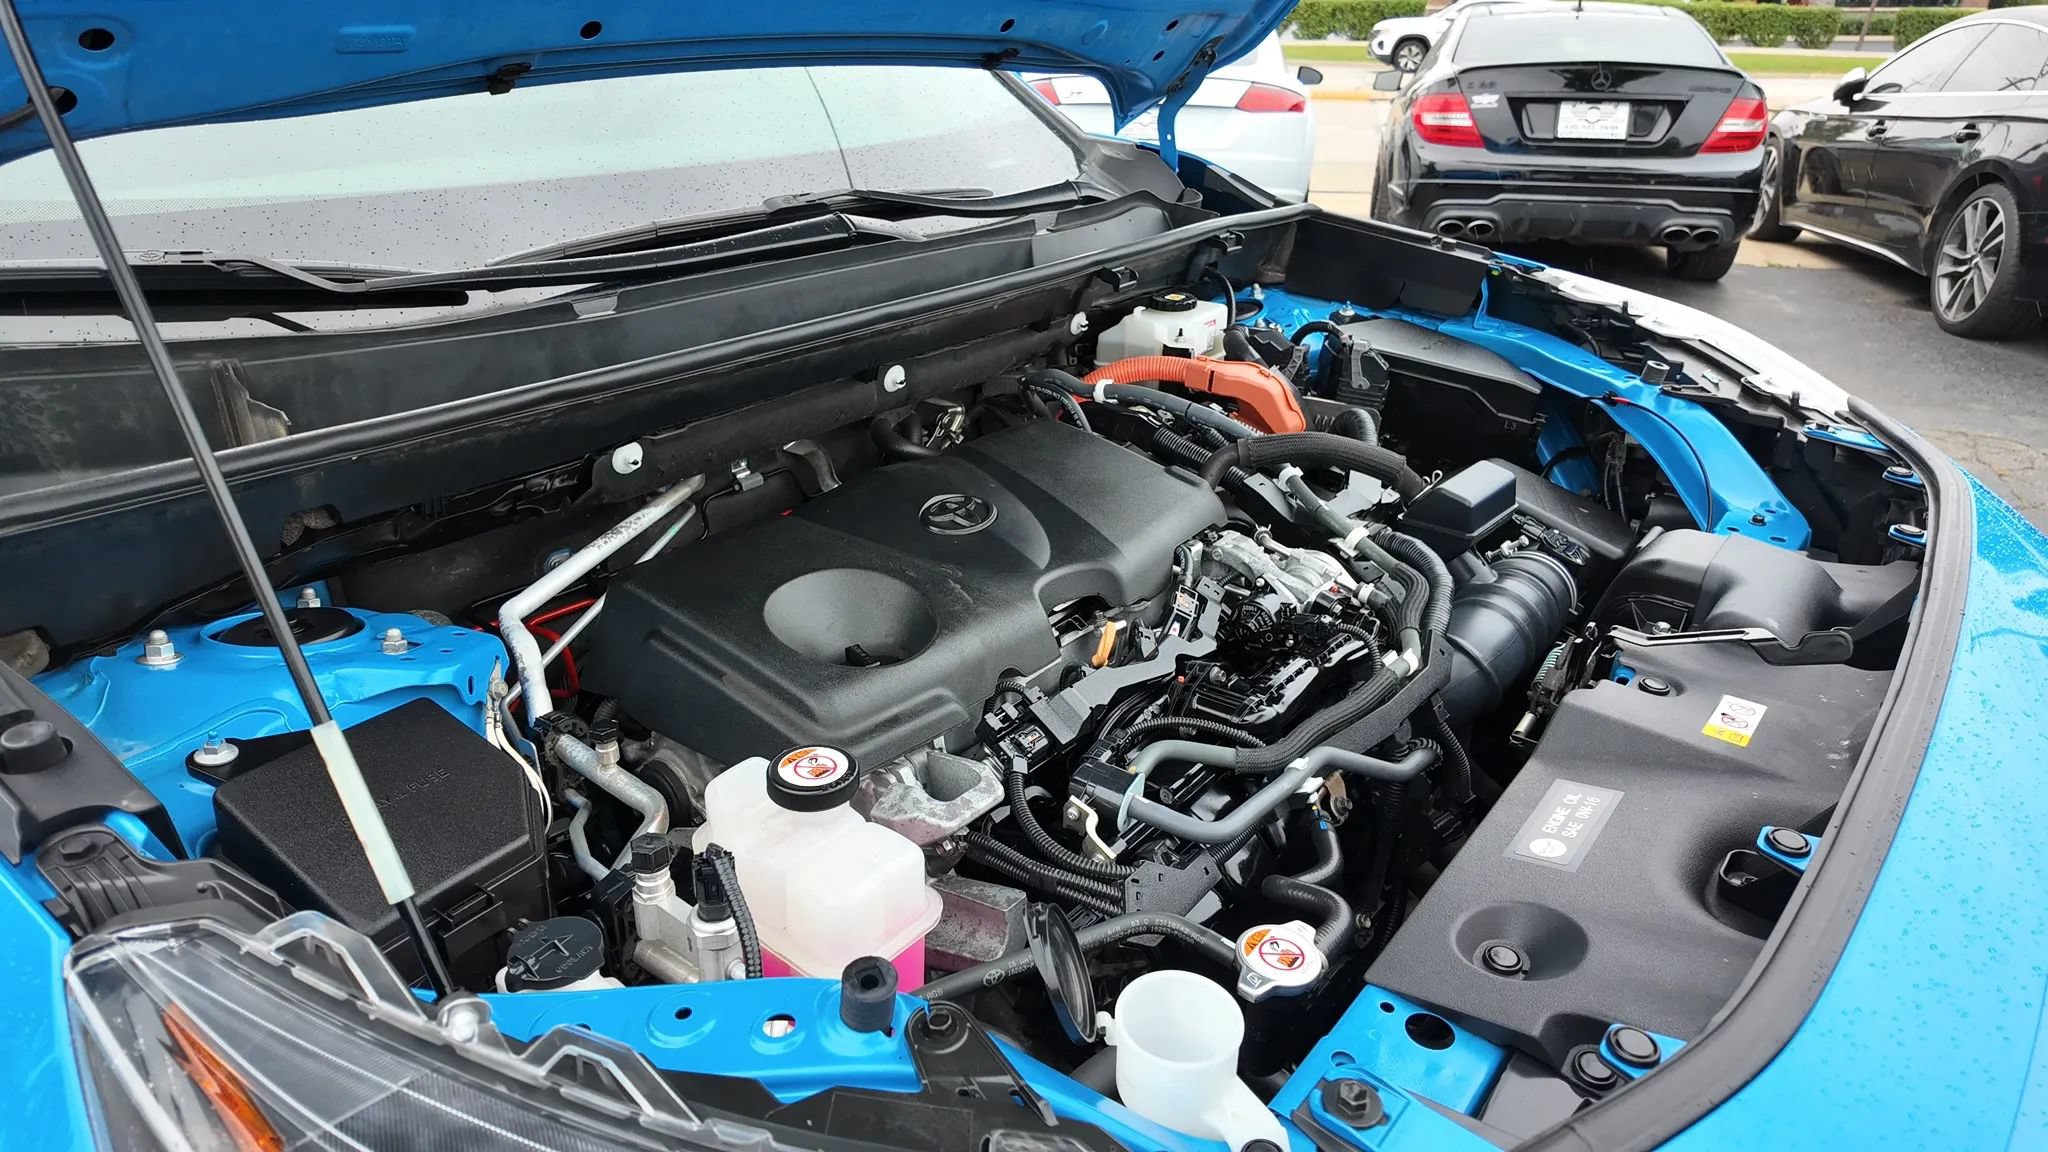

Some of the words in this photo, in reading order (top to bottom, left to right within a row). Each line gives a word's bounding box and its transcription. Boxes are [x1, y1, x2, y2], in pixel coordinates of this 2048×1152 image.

[406, 767, 451, 793] FUSE
[1542, 806, 1571, 833] ENGINE
[1563, 794, 1582, 805] OIL
[1561, 821, 1584, 838] SAE
